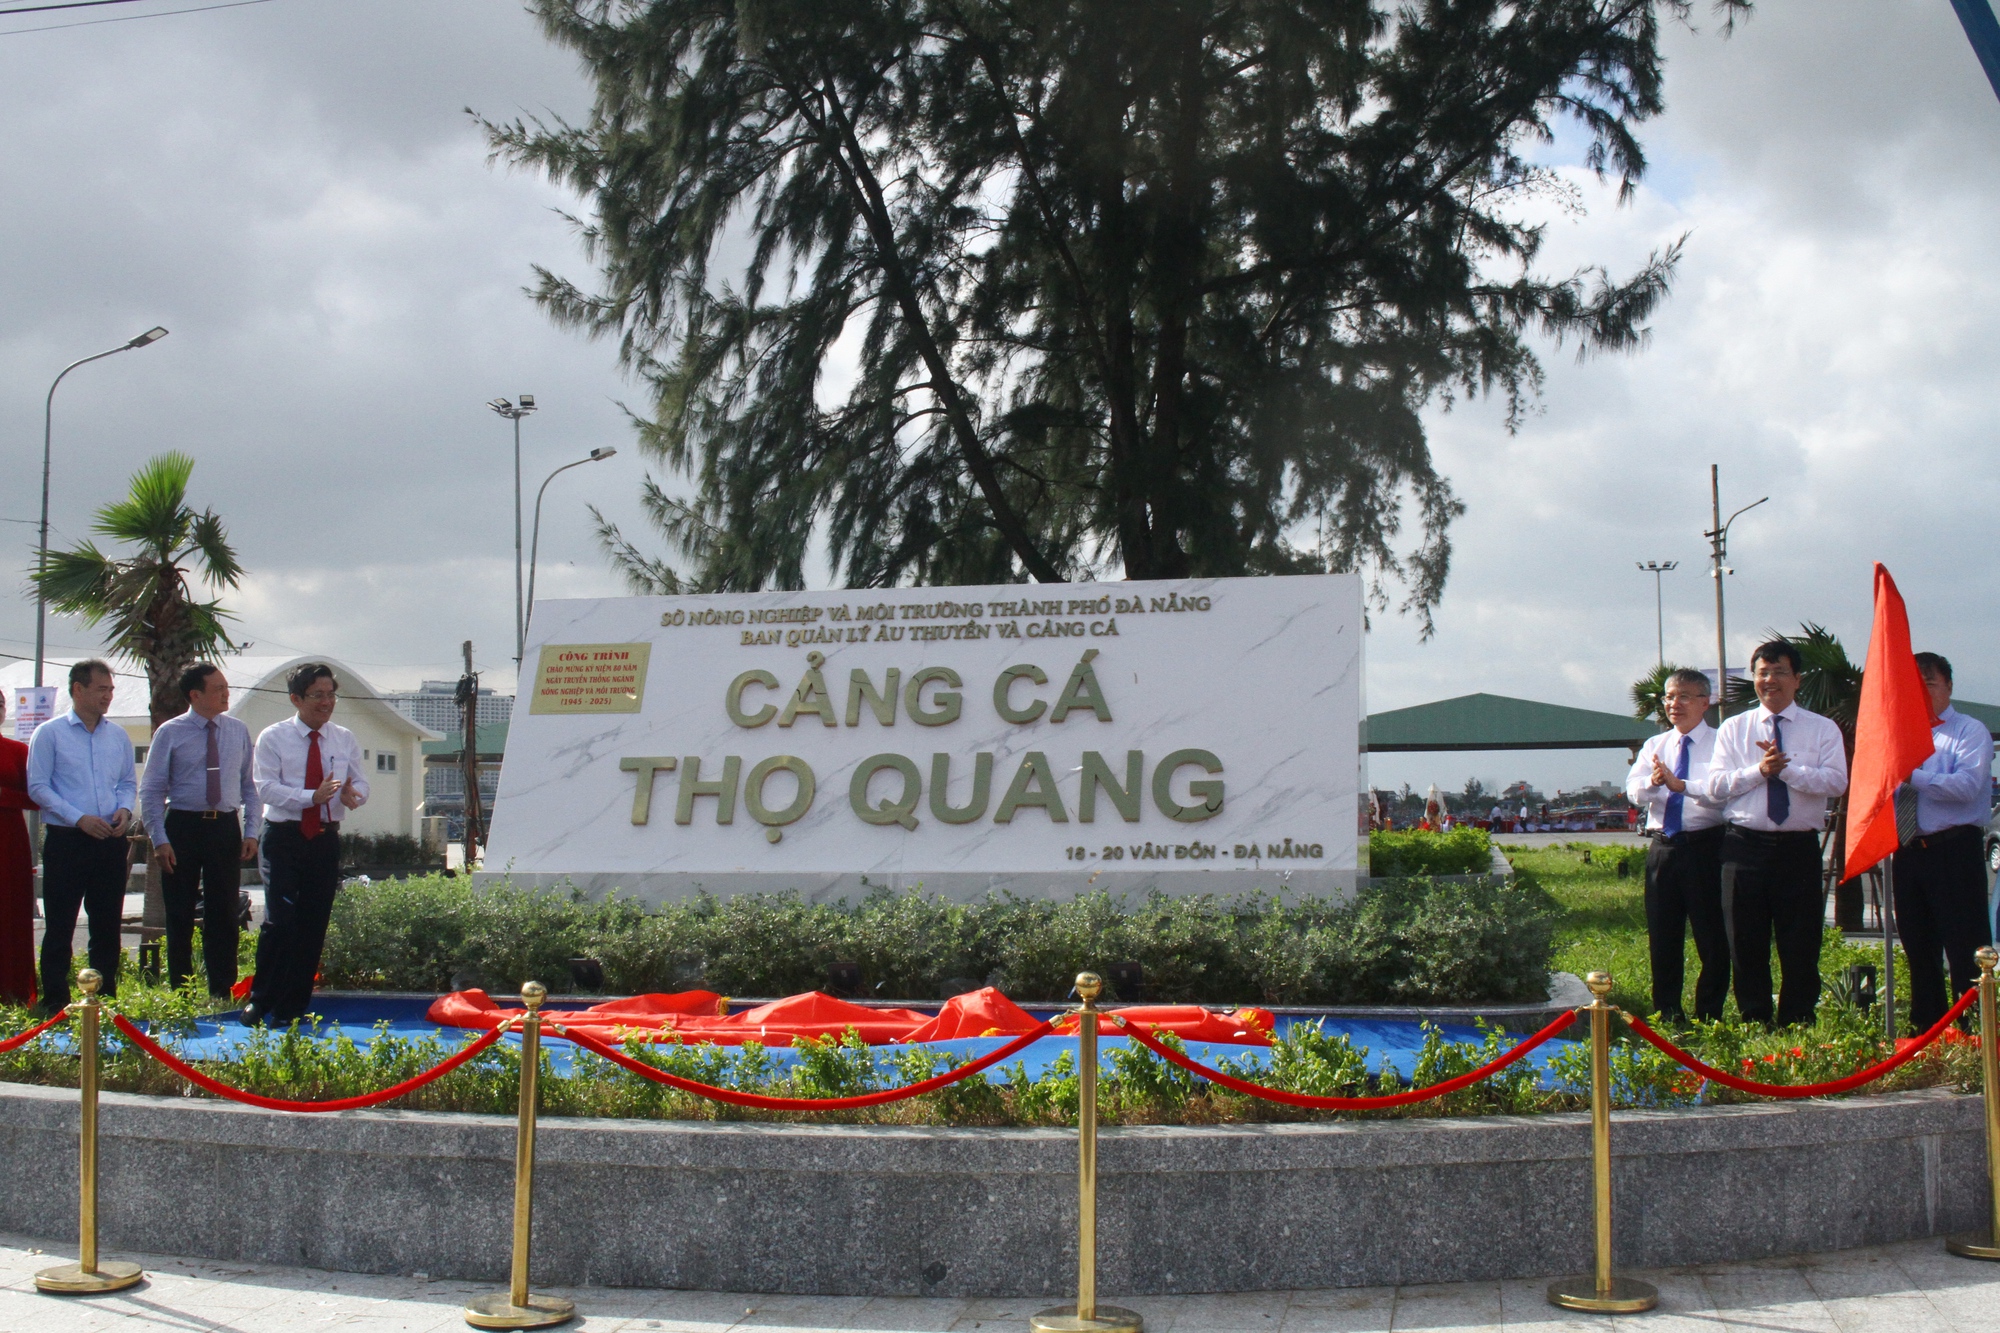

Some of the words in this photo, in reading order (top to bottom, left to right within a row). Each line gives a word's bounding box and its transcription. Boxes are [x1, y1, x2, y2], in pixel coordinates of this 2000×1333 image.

[688, 608, 744, 626] NÔNG
[748, 605, 823, 626] NGHIỆP
[827, 603, 851, 622] VÀ
[855, 602, 895, 621] MÔI
[900, 601, 983, 620] TRƯỜNG
[988, 598, 1063, 617] THÀNH
[1067, 594, 1111, 615] PHỐ
[1115, 595, 1146, 614] ĐÀ
[1150, 592, 1211, 613] NẴNG
[740, 629, 783, 646] BAN
[785, 625, 843, 648] QUẢN
[846, 625, 871, 643] LÝ
[874, 624, 904, 642] ÂU
[909, 619, 991, 641] THUYỀN
[995, 619, 1021, 639] VÀ
[1026, 619, 1086, 638] CẢNG
[1090, 617, 1120, 636] CÁ
[559, 651, 588, 662] CÔNG
[593, 650, 630, 661] TRÌNH
[613, 664, 622, 672] 80
[725, 650, 964, 728] CẢNG
[993, 649, 1113, 725] CÁ
[619, 755, 817, 844] THỌ
[849, 749, 1224, 832] QUANG
[1102, 846, 1124, 861] 20
[1130, 842, 1168, 861] VÂN
